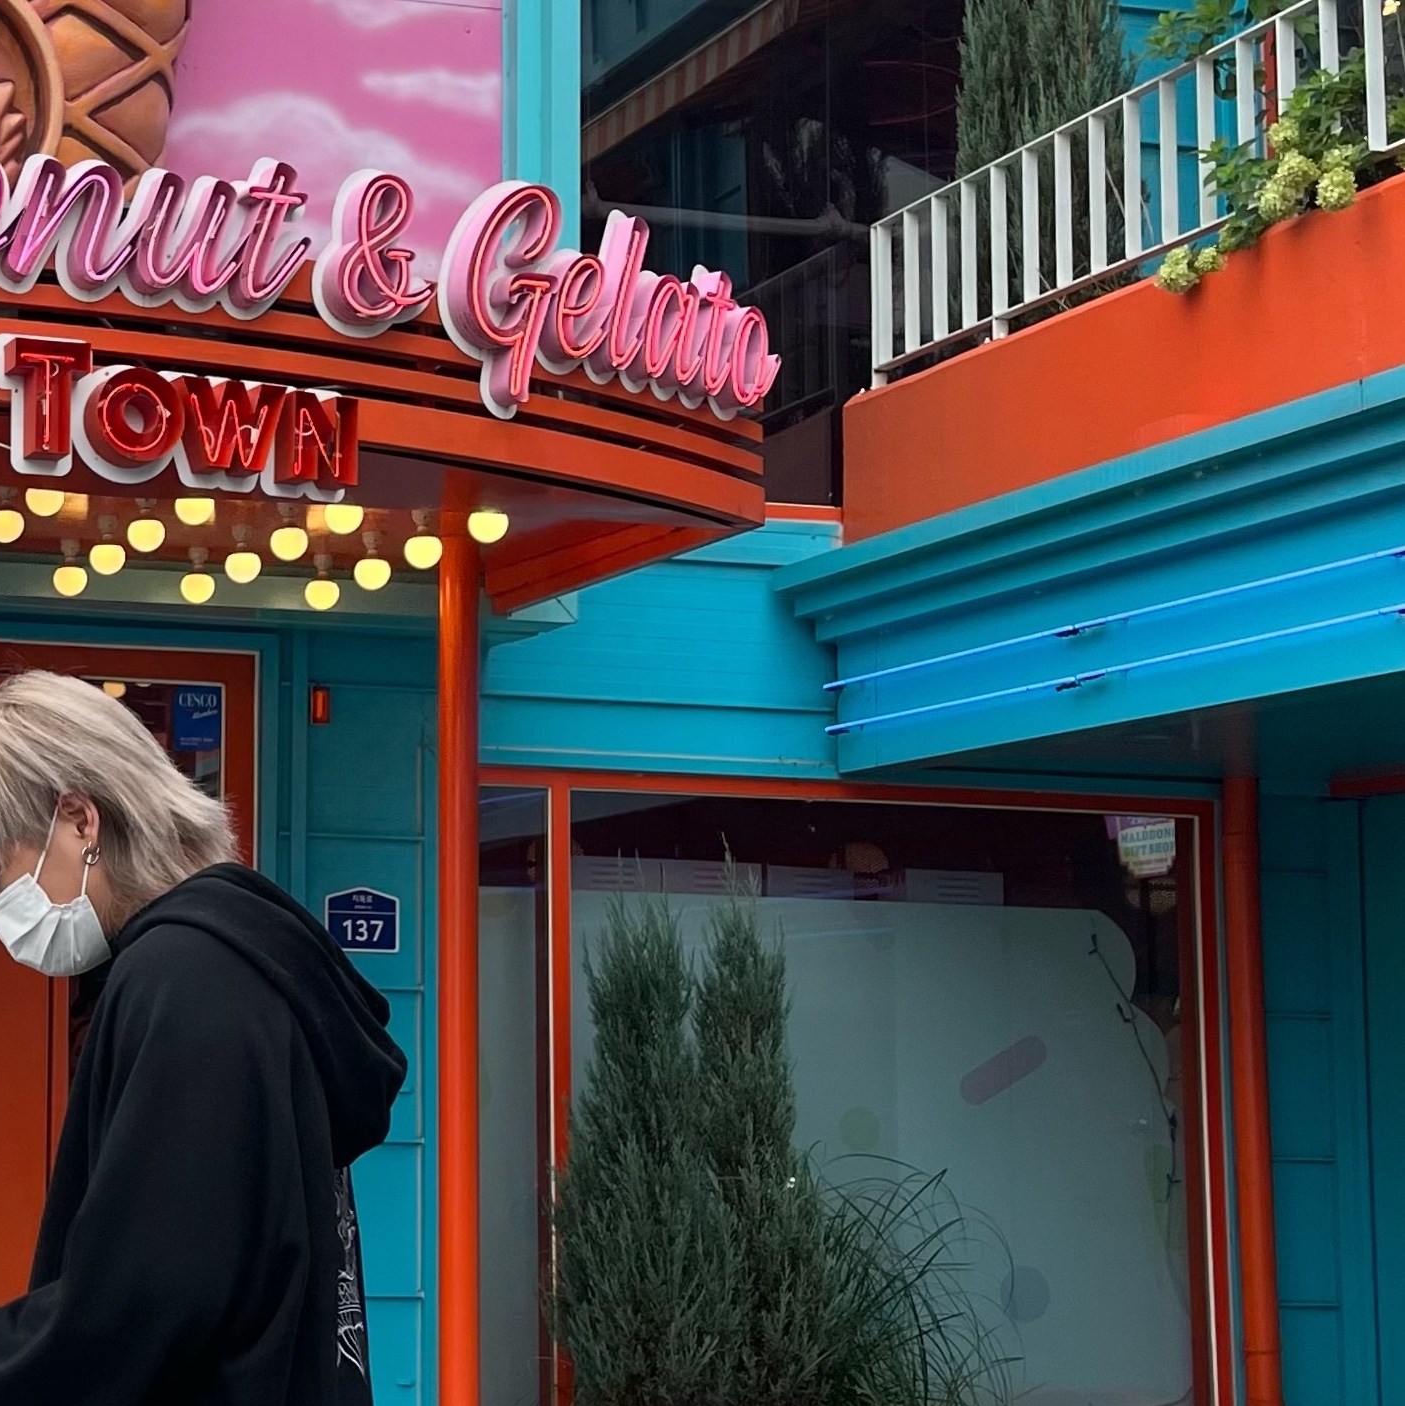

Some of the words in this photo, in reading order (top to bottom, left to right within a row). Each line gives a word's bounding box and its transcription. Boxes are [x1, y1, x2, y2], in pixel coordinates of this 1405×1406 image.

[313, 169, 436, 338] &
[438, 180, 782, 420] Gelato
[1120, 826, 1175, 844] MALDDON
[342, 918, 384, 942] 137
